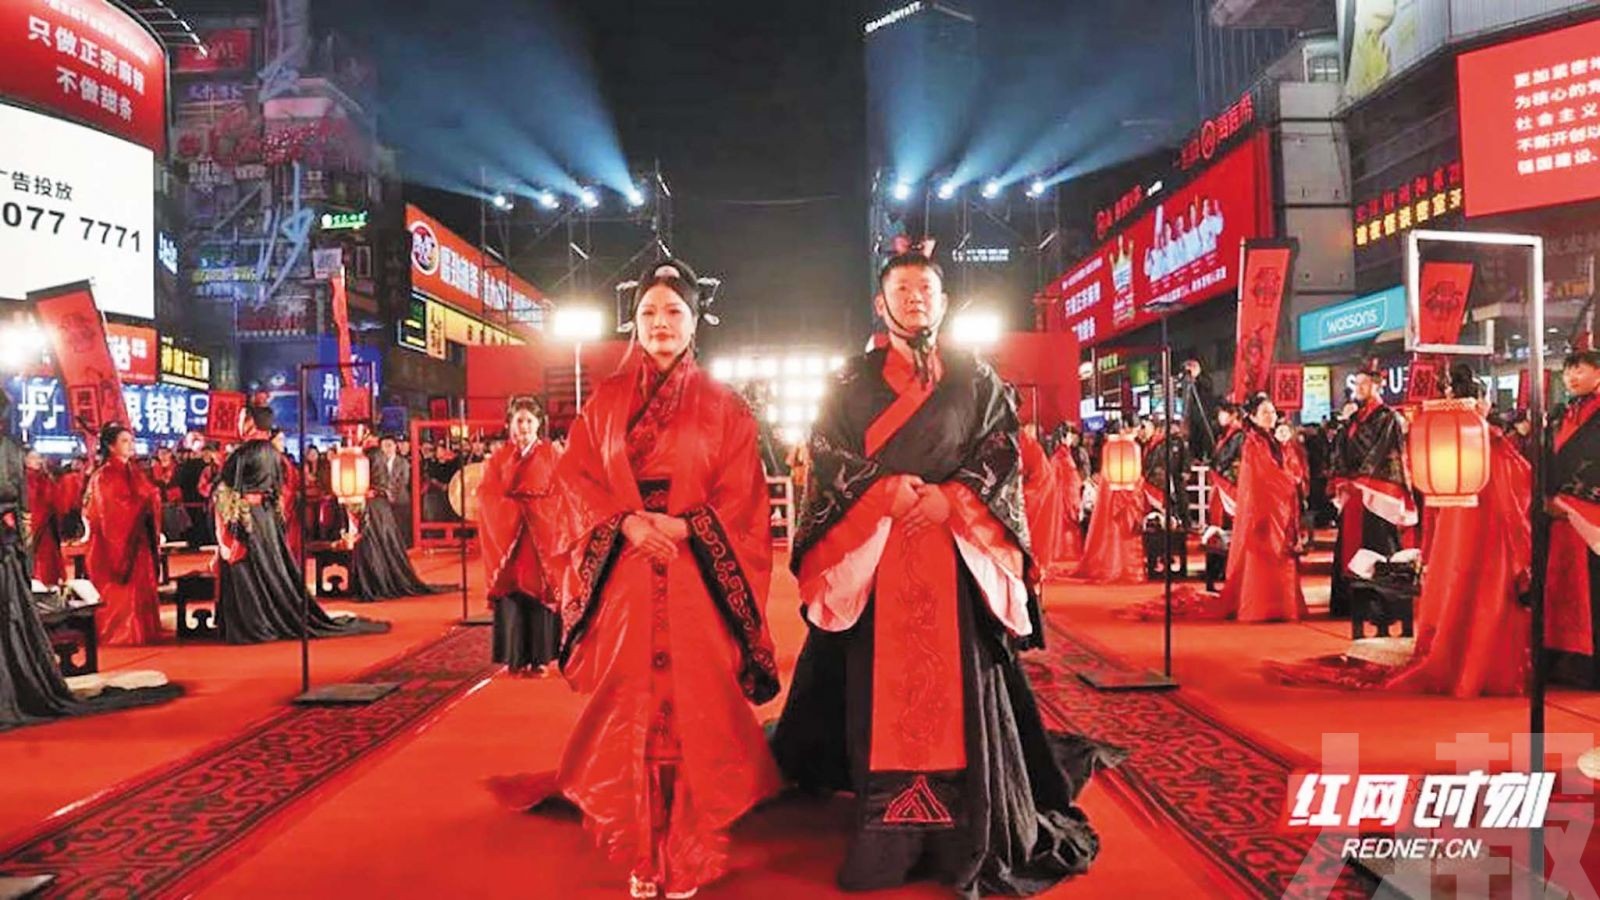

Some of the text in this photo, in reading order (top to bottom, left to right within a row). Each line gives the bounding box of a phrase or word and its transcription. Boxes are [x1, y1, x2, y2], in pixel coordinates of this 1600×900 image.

[1515, 101, 1598, 132] 社会主义
[0, 169, 73, 202] 告投放
[2, 201, 66, 235] 077
[79, 216, 141, 253] 7771
[1326, 309, 1377, 334] watsons
